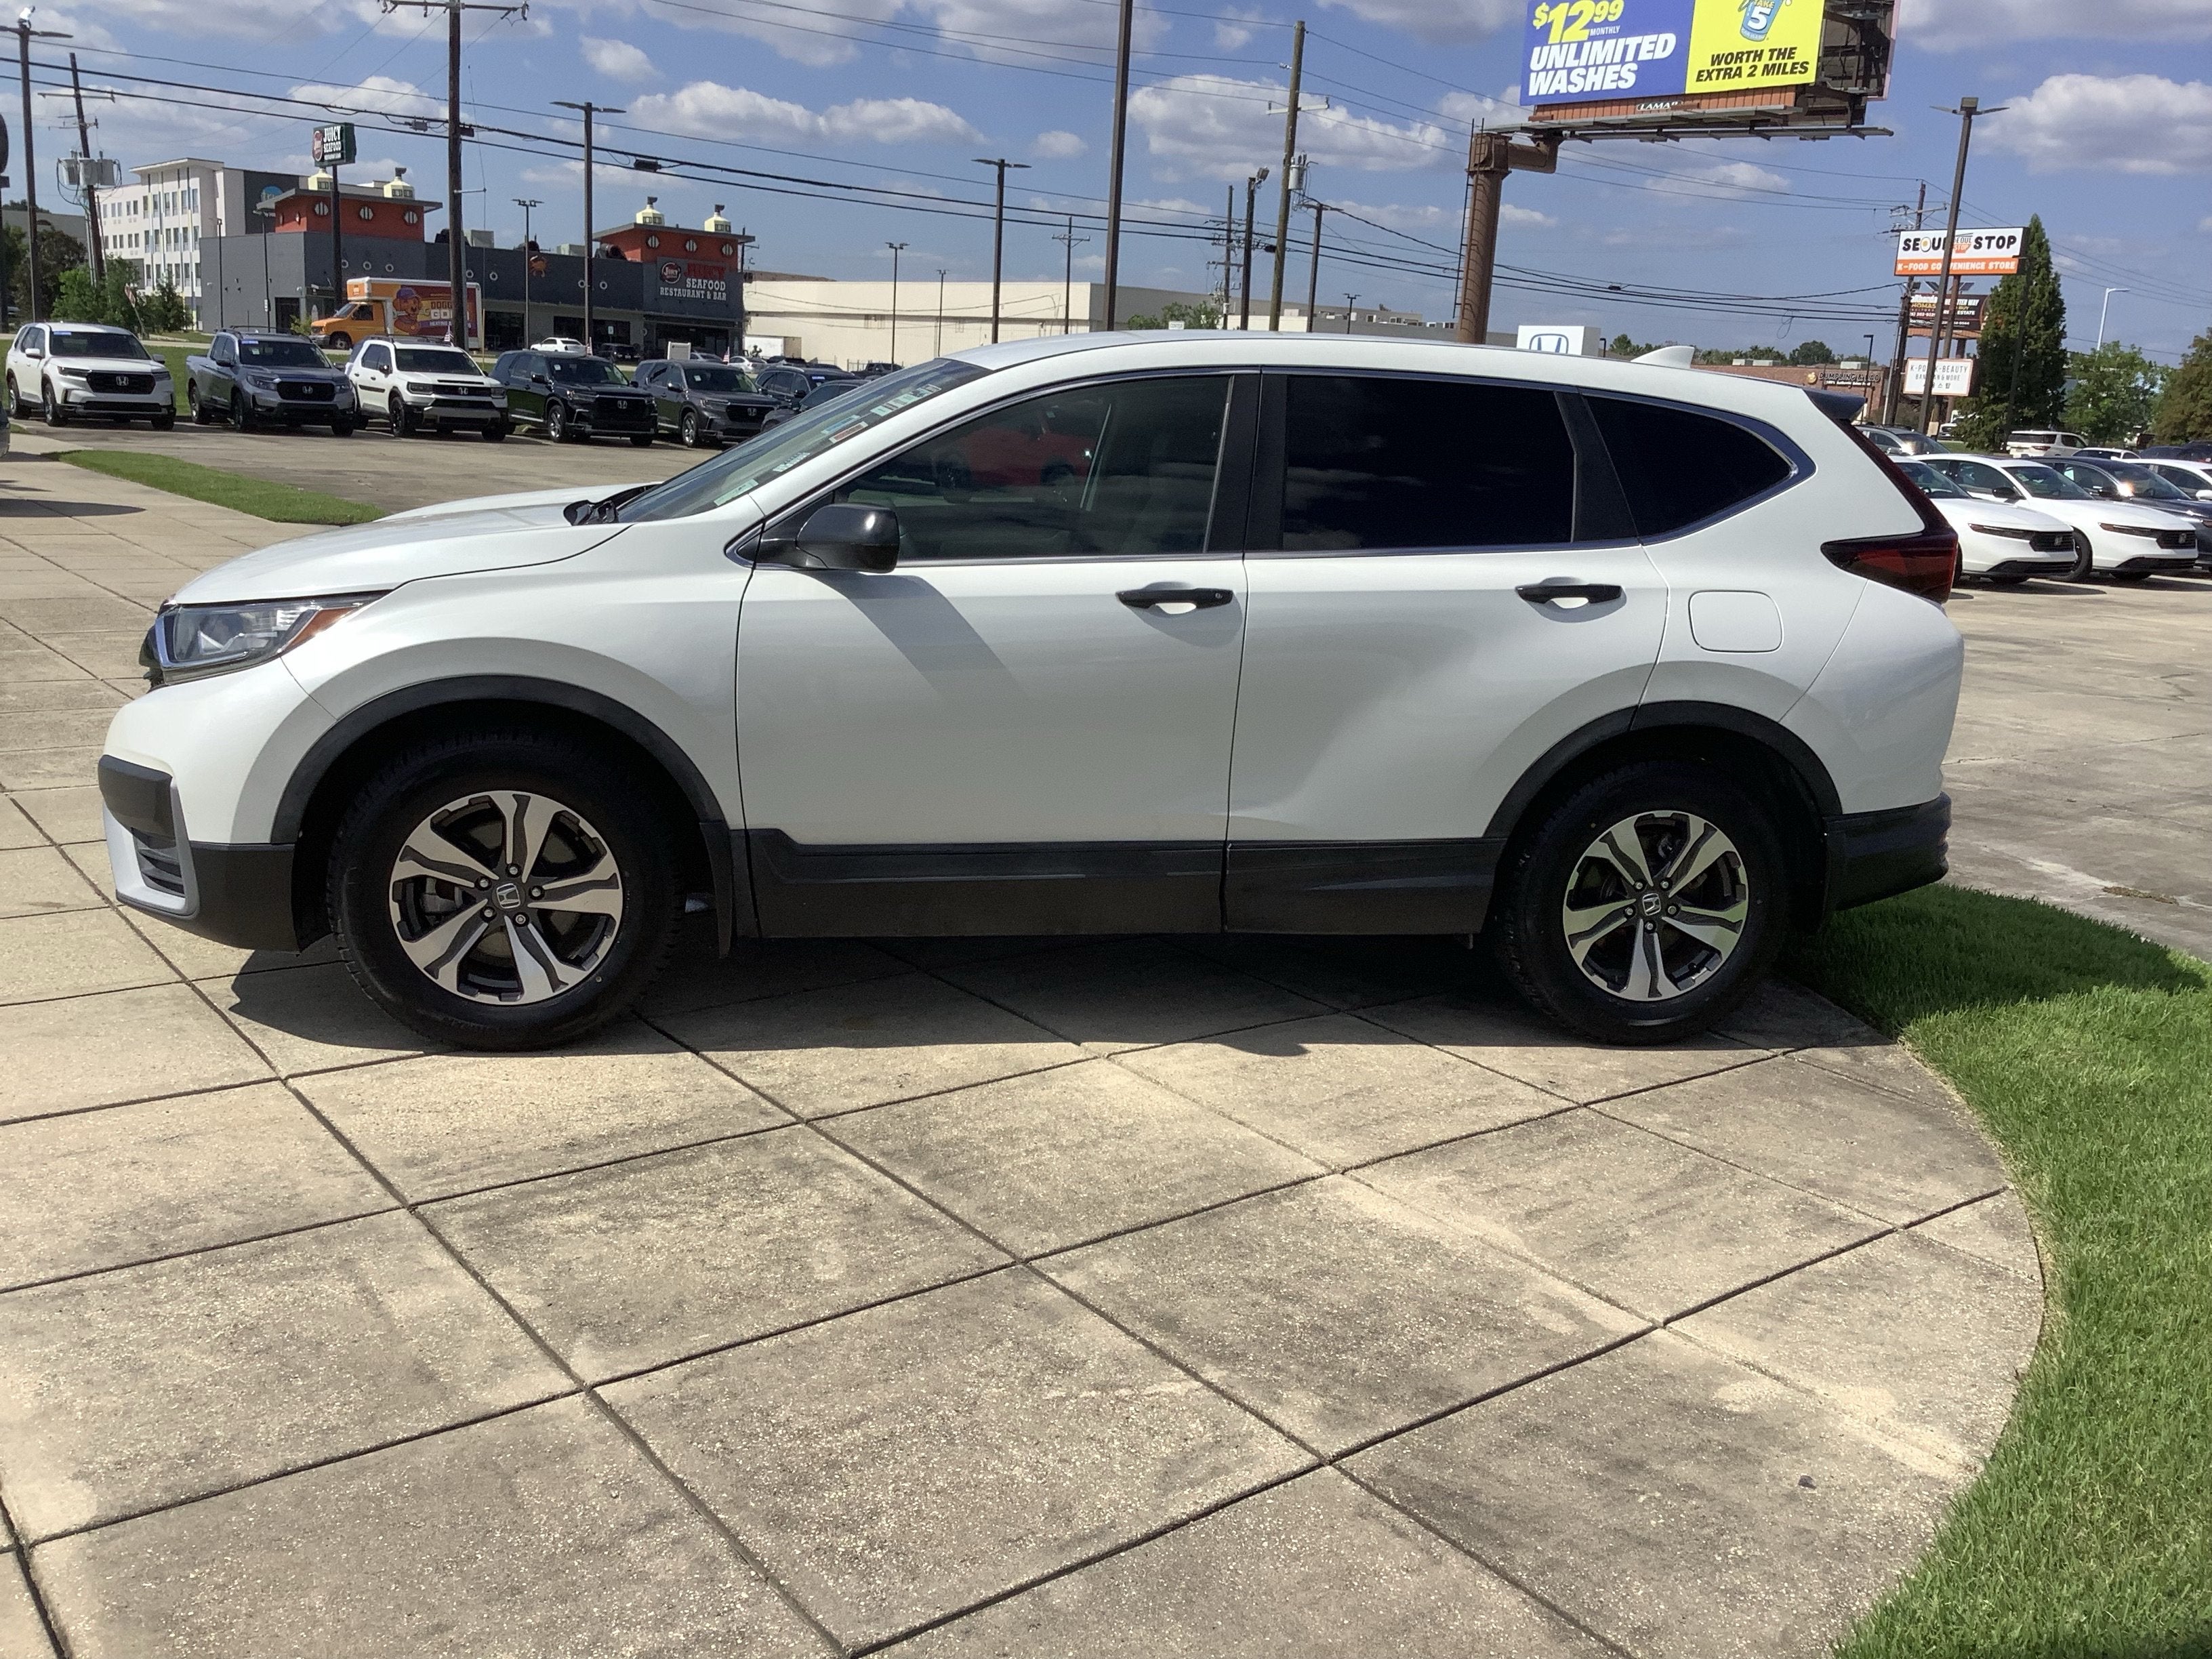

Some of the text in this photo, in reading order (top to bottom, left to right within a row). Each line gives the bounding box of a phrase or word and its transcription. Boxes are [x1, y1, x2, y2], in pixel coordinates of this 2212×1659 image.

[1747, 6, 1772, 30] 5
[1590, 25, 1621, 37] MONTHLY
[1530, 33, 1677, 71] UNLIMITED
[1710, 47, 1798, 66] WORTH THE
[1528, 62, 1639, 96] WASHES
[1696, 61, 1810, 83] EXTRA 2 MILES
[323, 125, 341, 142] JUICY
[1973, 234, 2018, 250] STOP
[1898, 261, 2015, 271] K-FOOD COVENIENCE STORE
[686, 278, 726, 291] SEAFOOD
[660, 287, 726, 301] RESTAURANT & BAR
[1910, 364, 1927, 372] K-PO
[1819, 373, 1856, 381] DUMPLING
